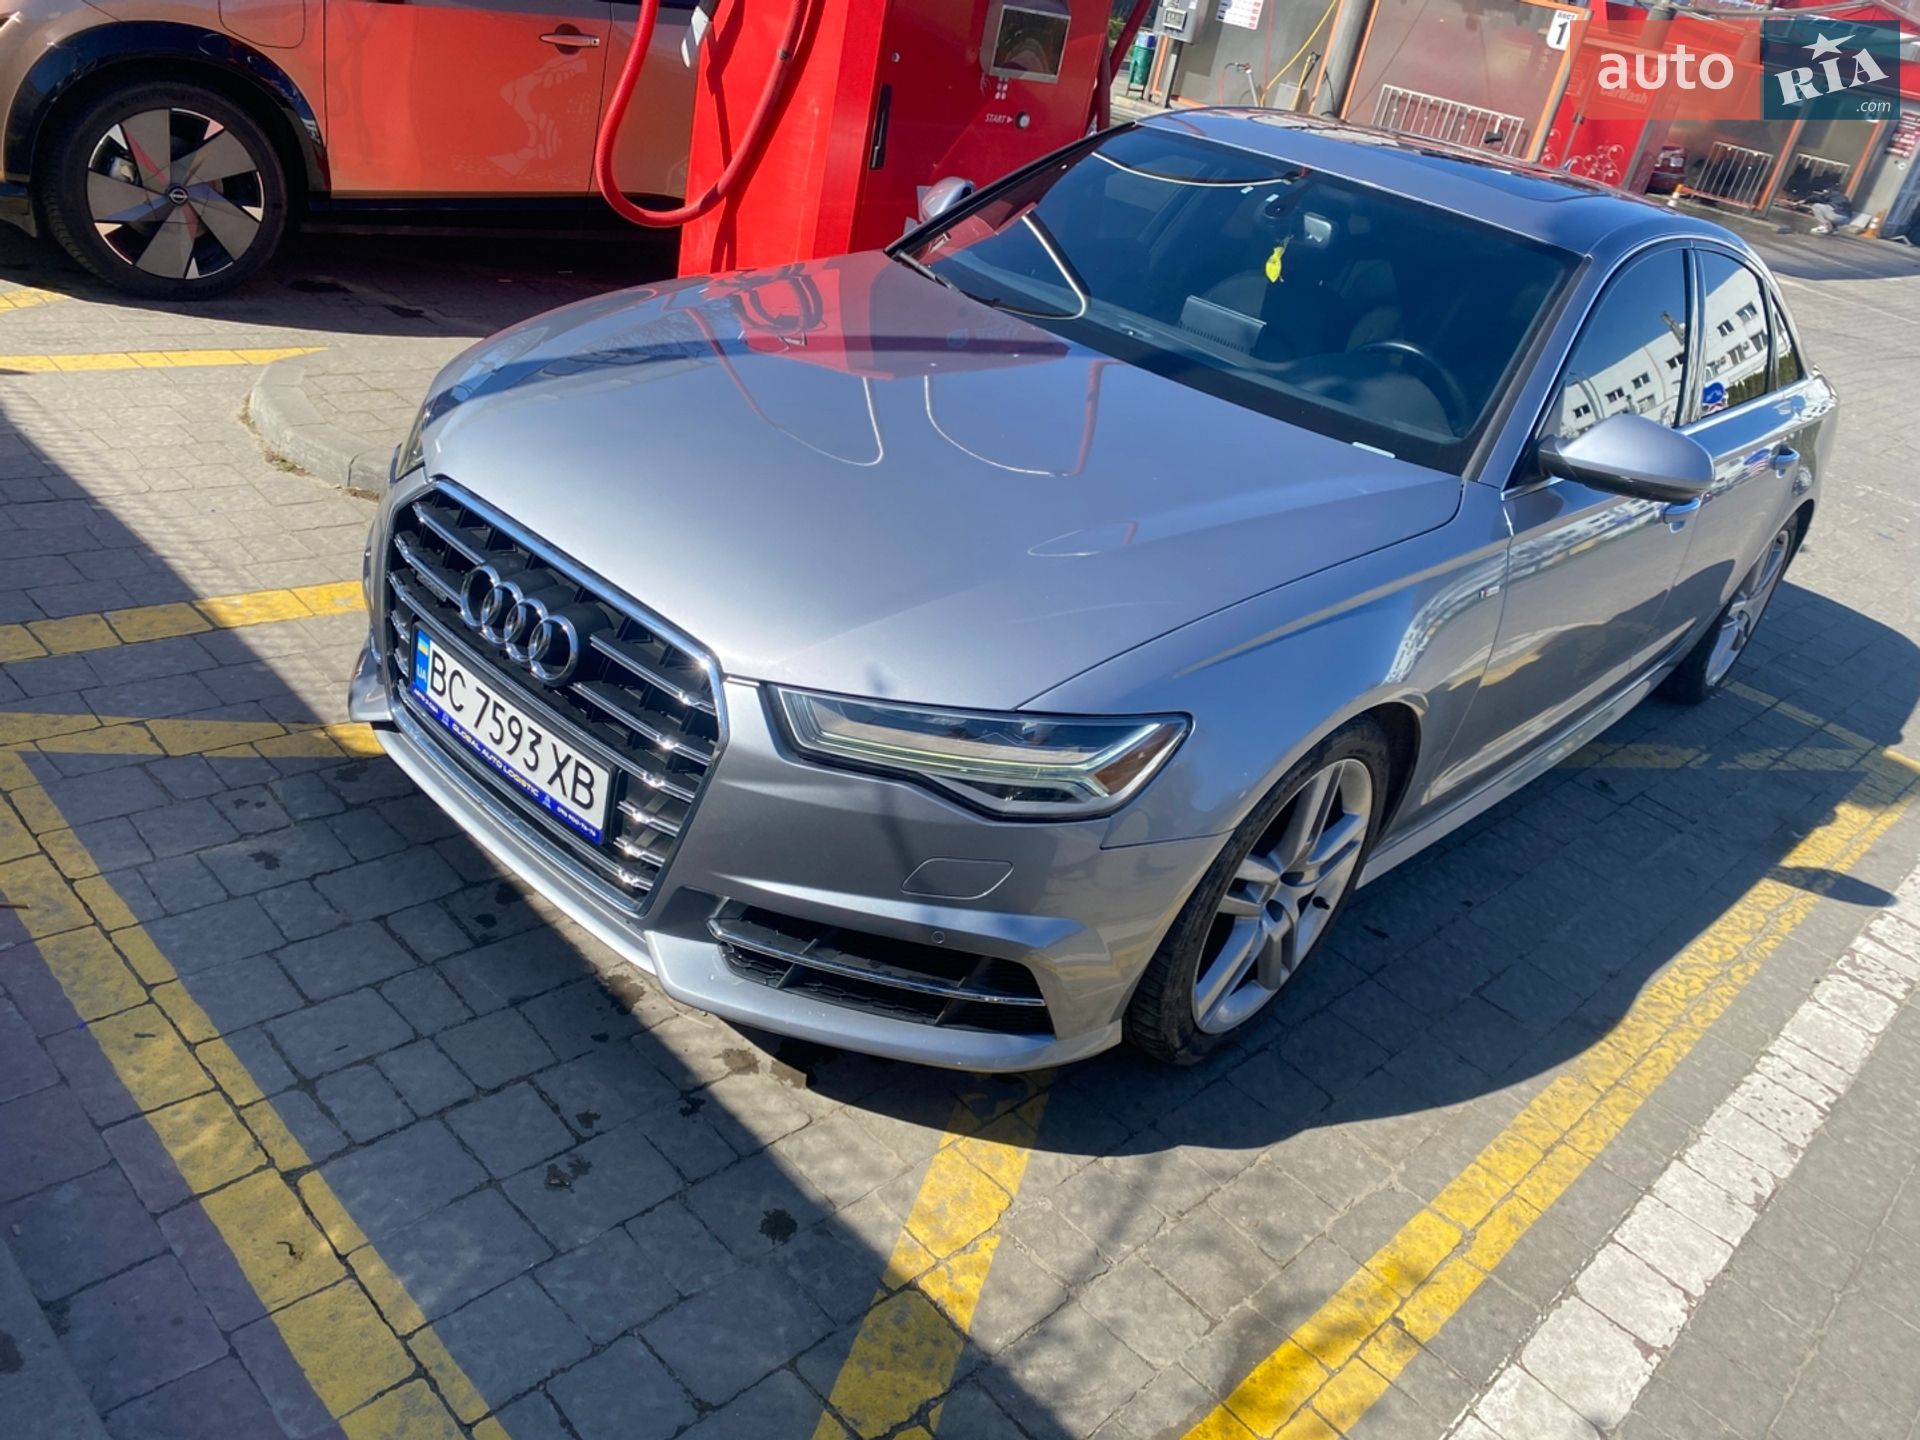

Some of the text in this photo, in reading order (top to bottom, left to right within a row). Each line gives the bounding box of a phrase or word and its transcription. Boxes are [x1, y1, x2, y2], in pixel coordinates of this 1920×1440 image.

[1556, 22, 1568, 44] 1
[984, 112, 1007, 124] START
[416, 664, 428, 683] UA
[430, 649, 594, 810] BC 7593 XB
[452, 723, 540, 797] GLOBAL AUTO LOGISTIC
